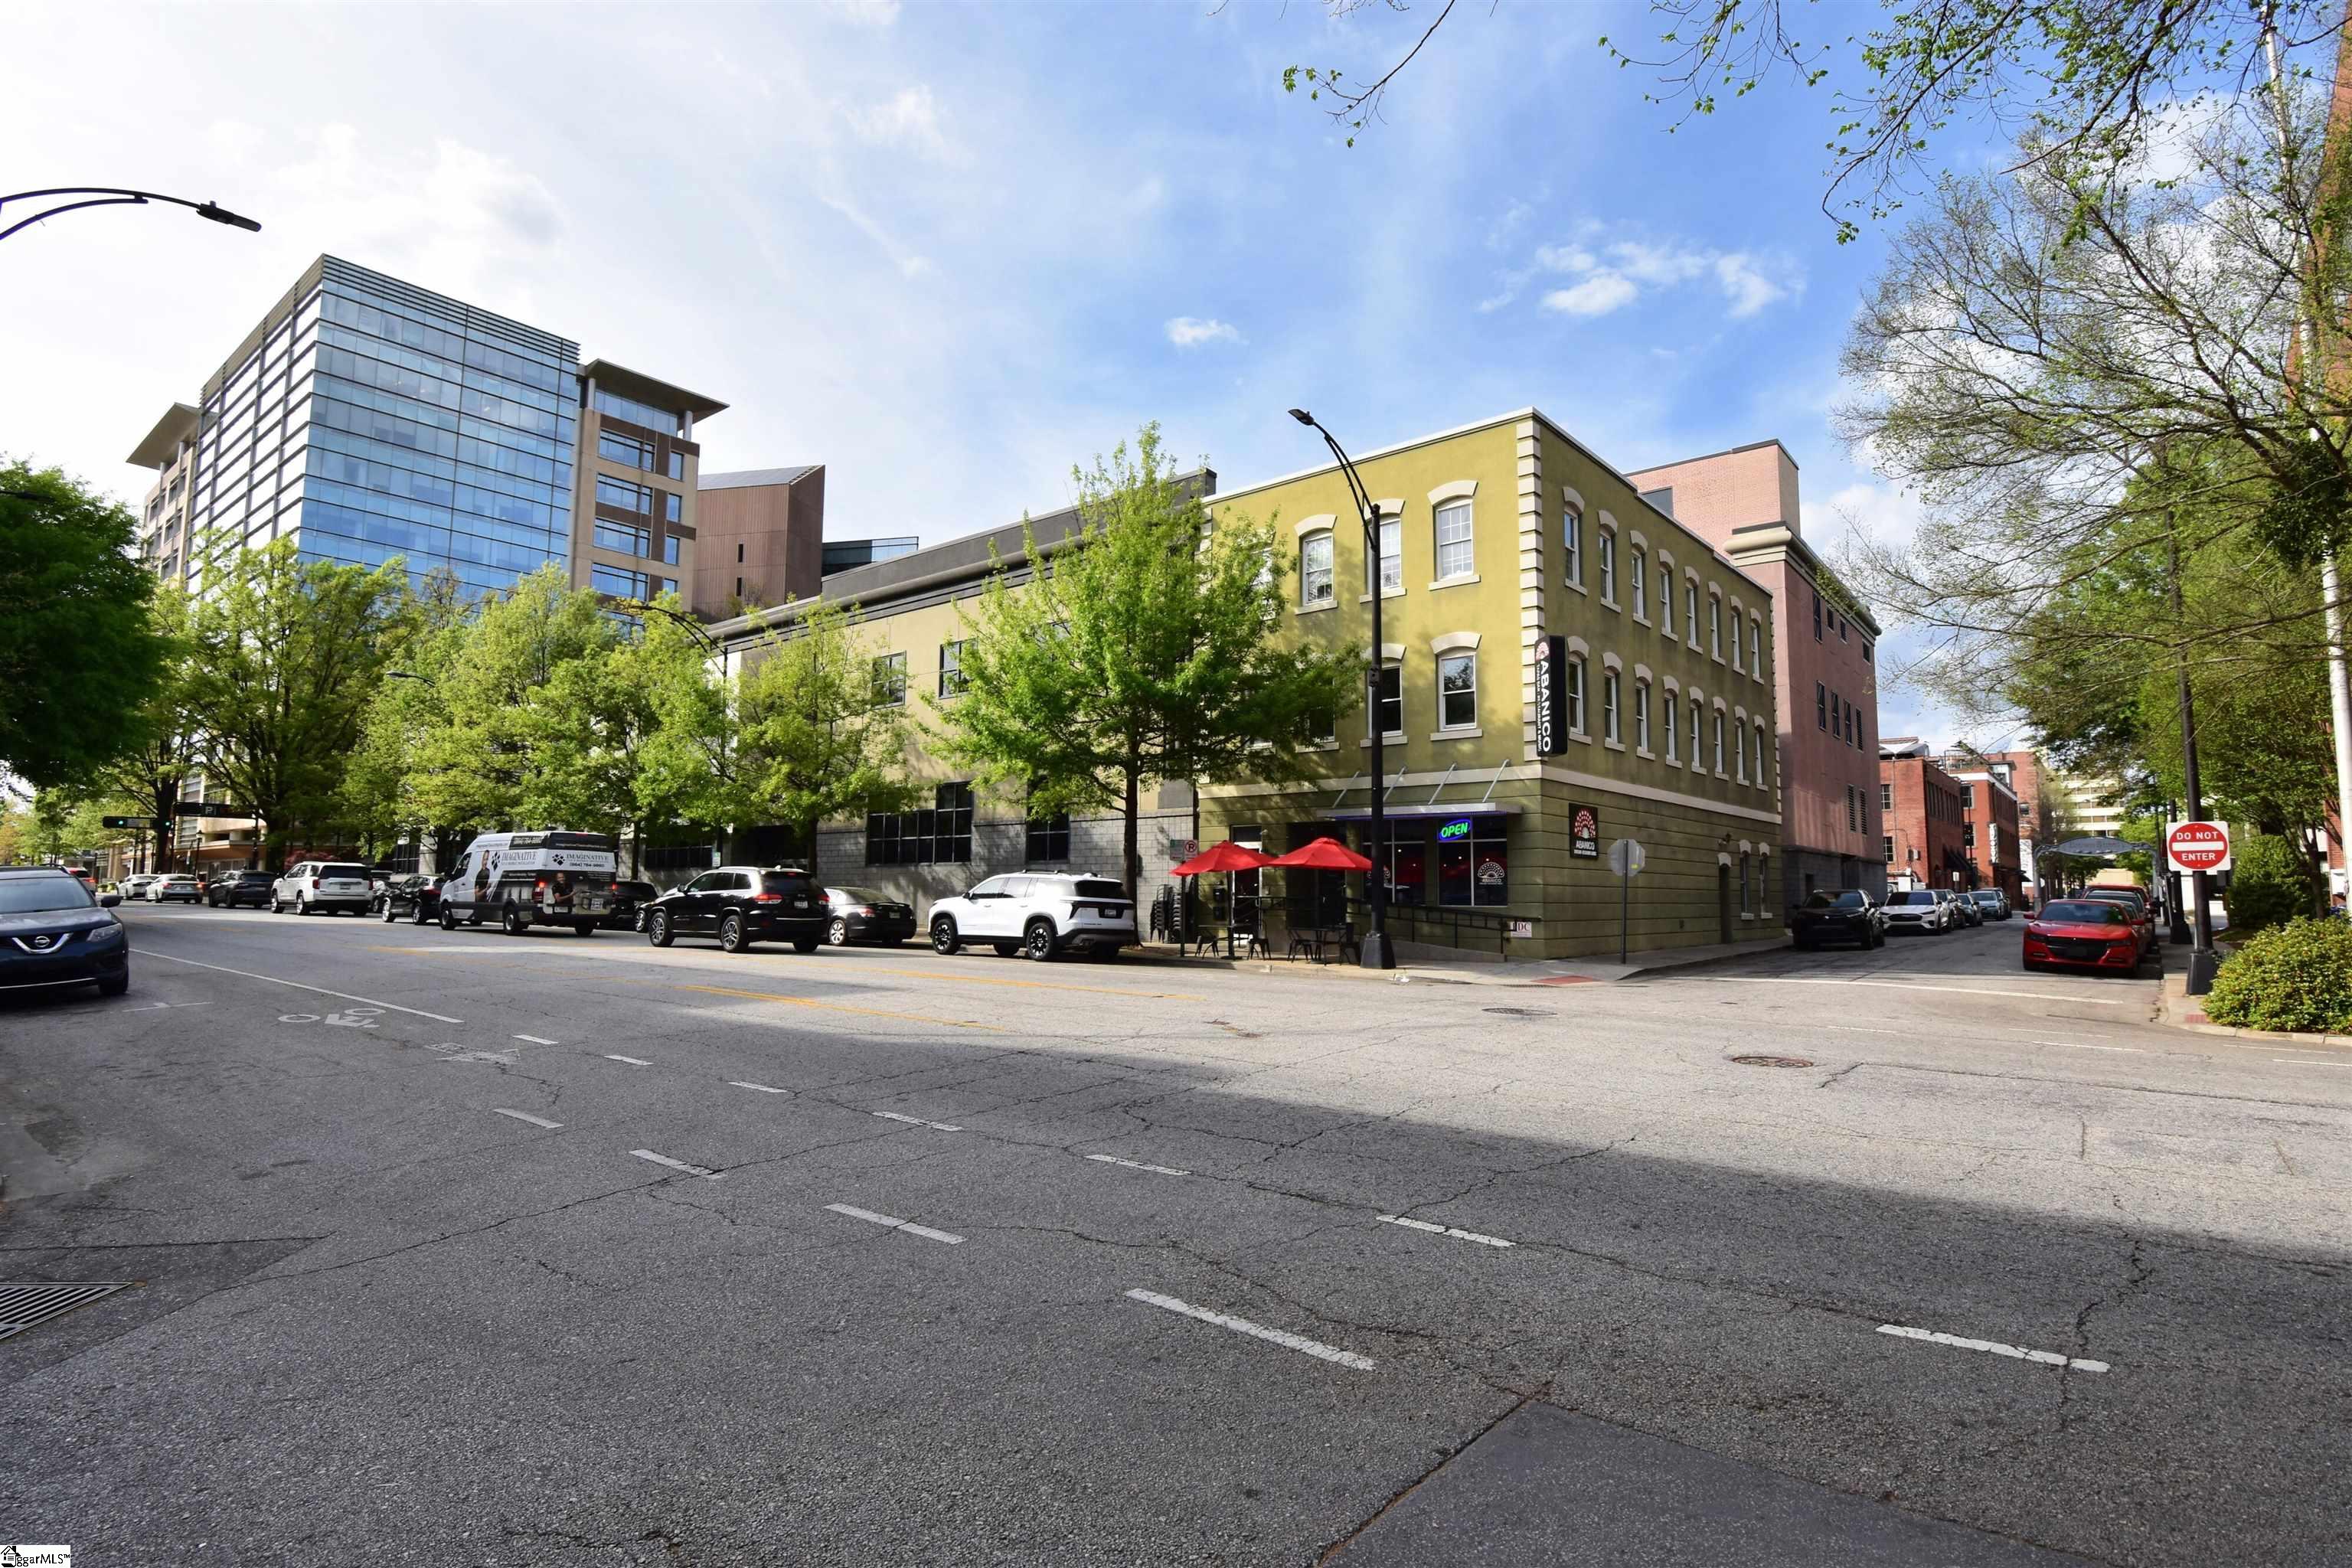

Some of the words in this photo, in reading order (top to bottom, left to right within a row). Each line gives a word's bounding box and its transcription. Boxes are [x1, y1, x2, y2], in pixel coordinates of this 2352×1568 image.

[1540, 661, 1551, 753] ABANICO
[1440, 822, 1468, 838] OPEN
[2181, 852, 2216, 861] ENTER
